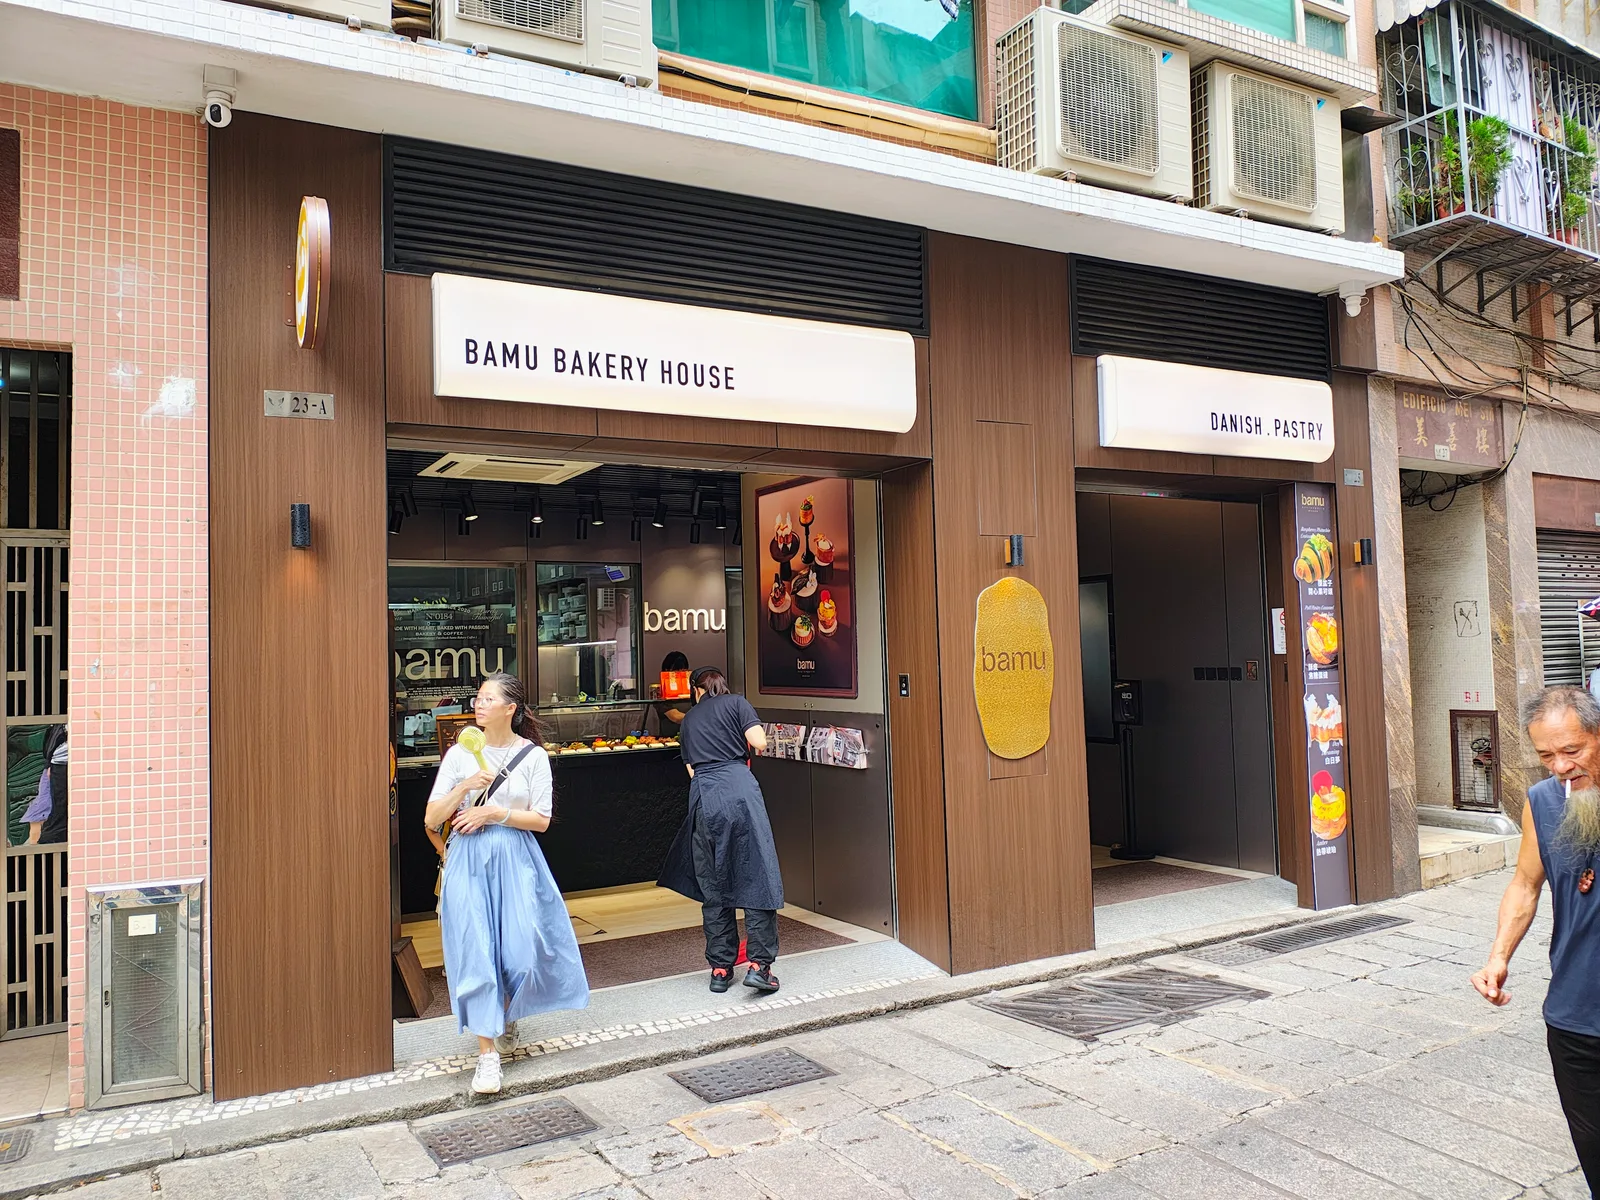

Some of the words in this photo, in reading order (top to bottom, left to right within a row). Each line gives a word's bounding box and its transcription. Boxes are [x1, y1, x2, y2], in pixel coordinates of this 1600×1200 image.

[464, 338, 538, 371] BAMU
[554, 347, 649, 383] BAKERY
[660, 360, 735, 391] HOUSE
[291, 396, 327, 415] 23-A
[1403, 392, 1447, 414] EDIFICIO
[1455, 401, 1472, 418] MEI
[1210, 411, 1262, 435] DANISH
[1274, 418, 1323, 441] PASTRY
[1301, 493, 1325, 507] bamu
[643, 601, 727, 633] bamu
[796, 657, 816, 670] bamu
[982, 646, 1047, 672] bamu
